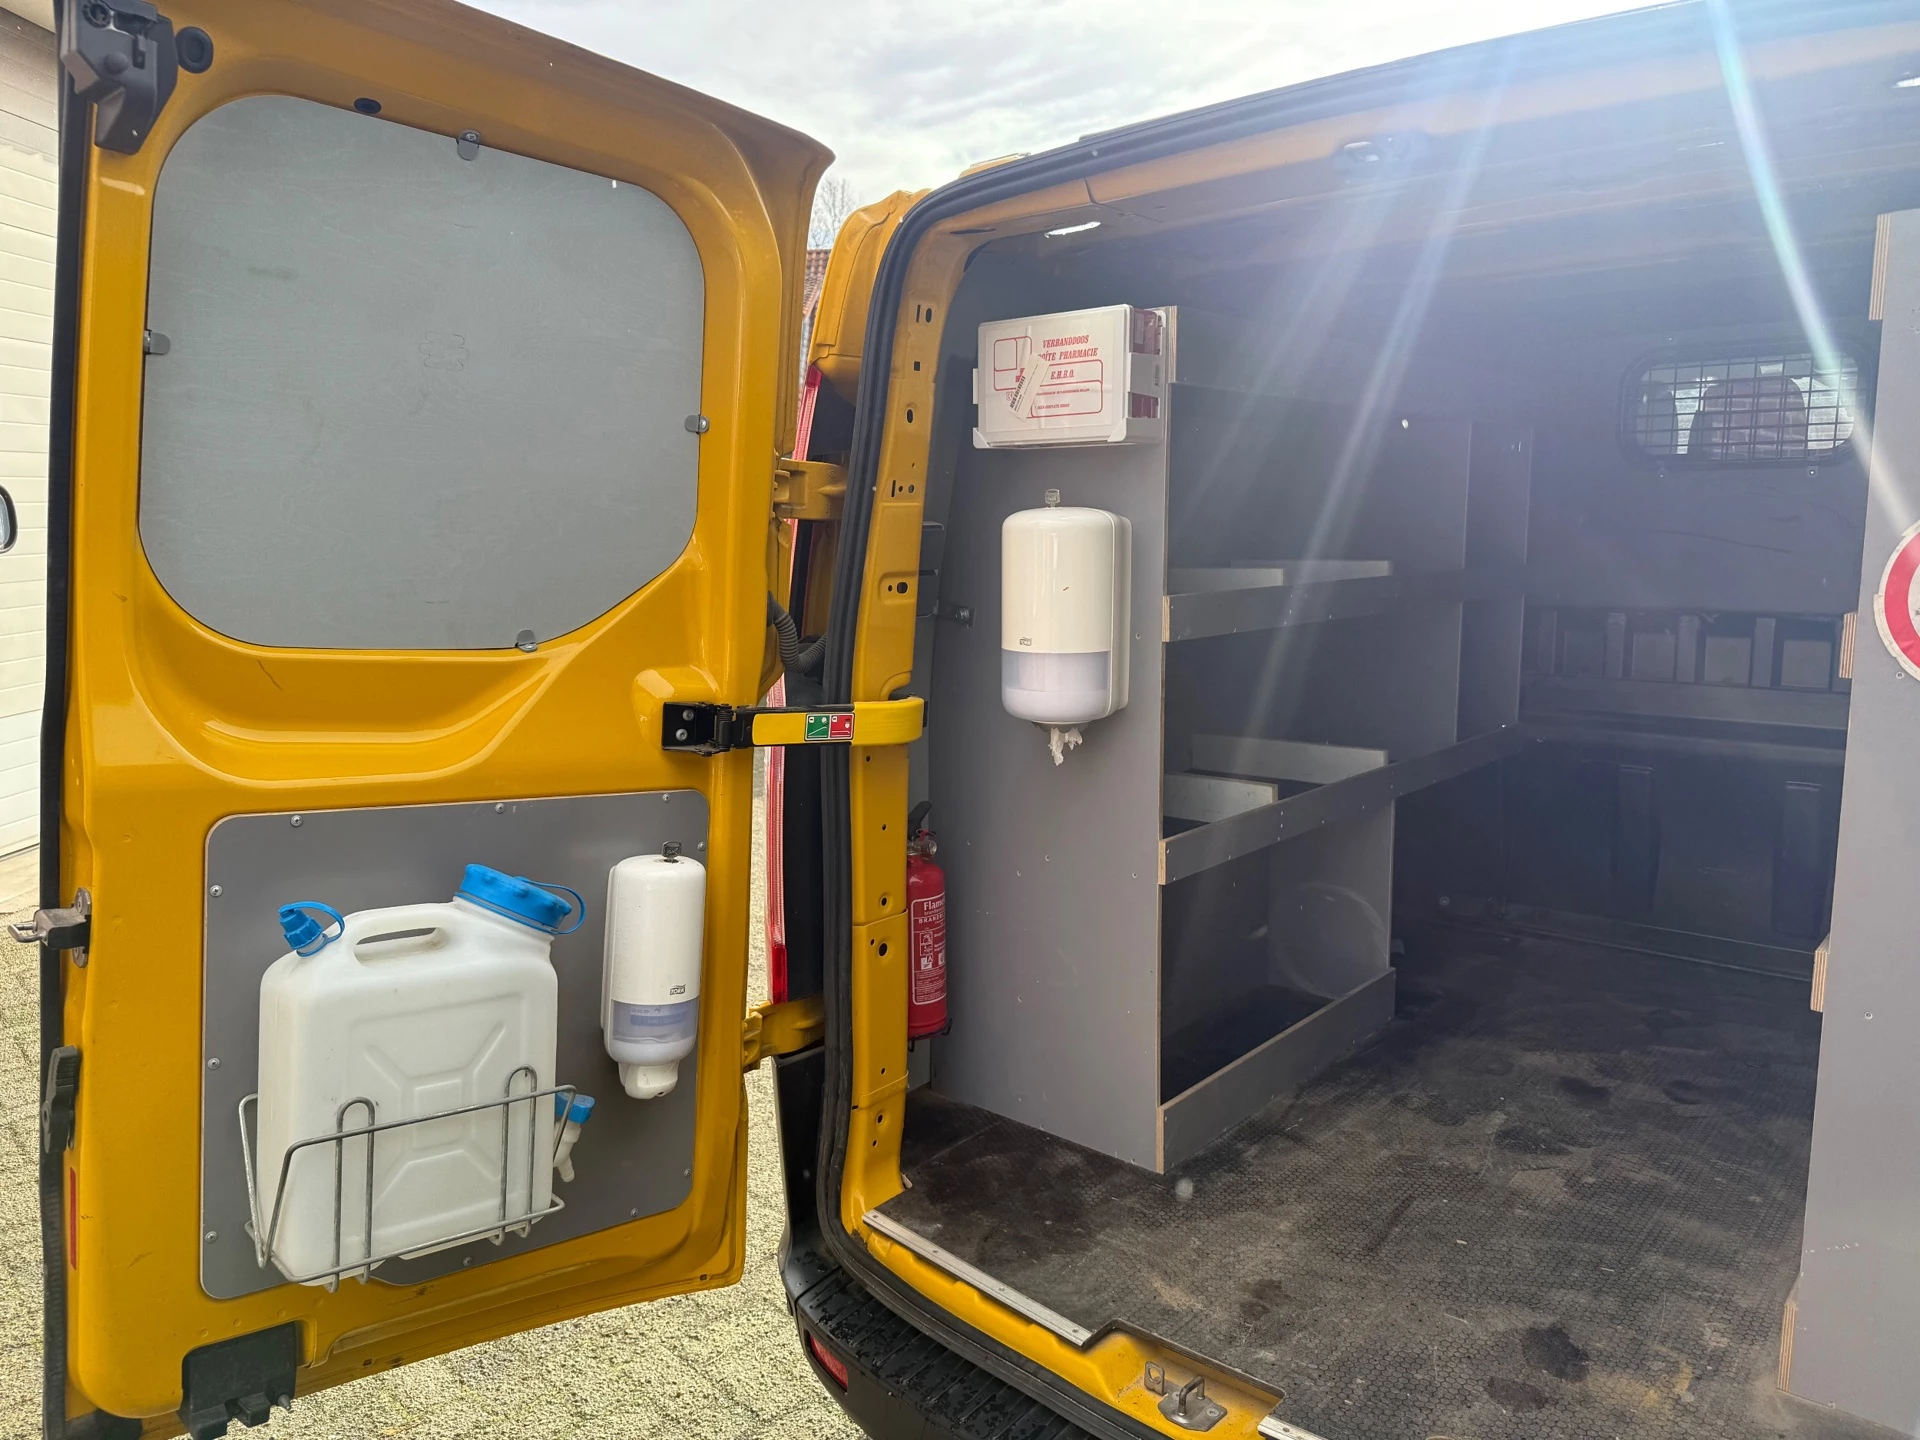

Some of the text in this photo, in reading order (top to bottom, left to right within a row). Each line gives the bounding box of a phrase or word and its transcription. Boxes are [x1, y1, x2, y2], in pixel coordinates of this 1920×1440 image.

[1043, 335, 1089, 348] VERBANDDOOS
[1059, 348, 1098, 360] PHARMACIE
[670, 987, 686, 996] TORK
